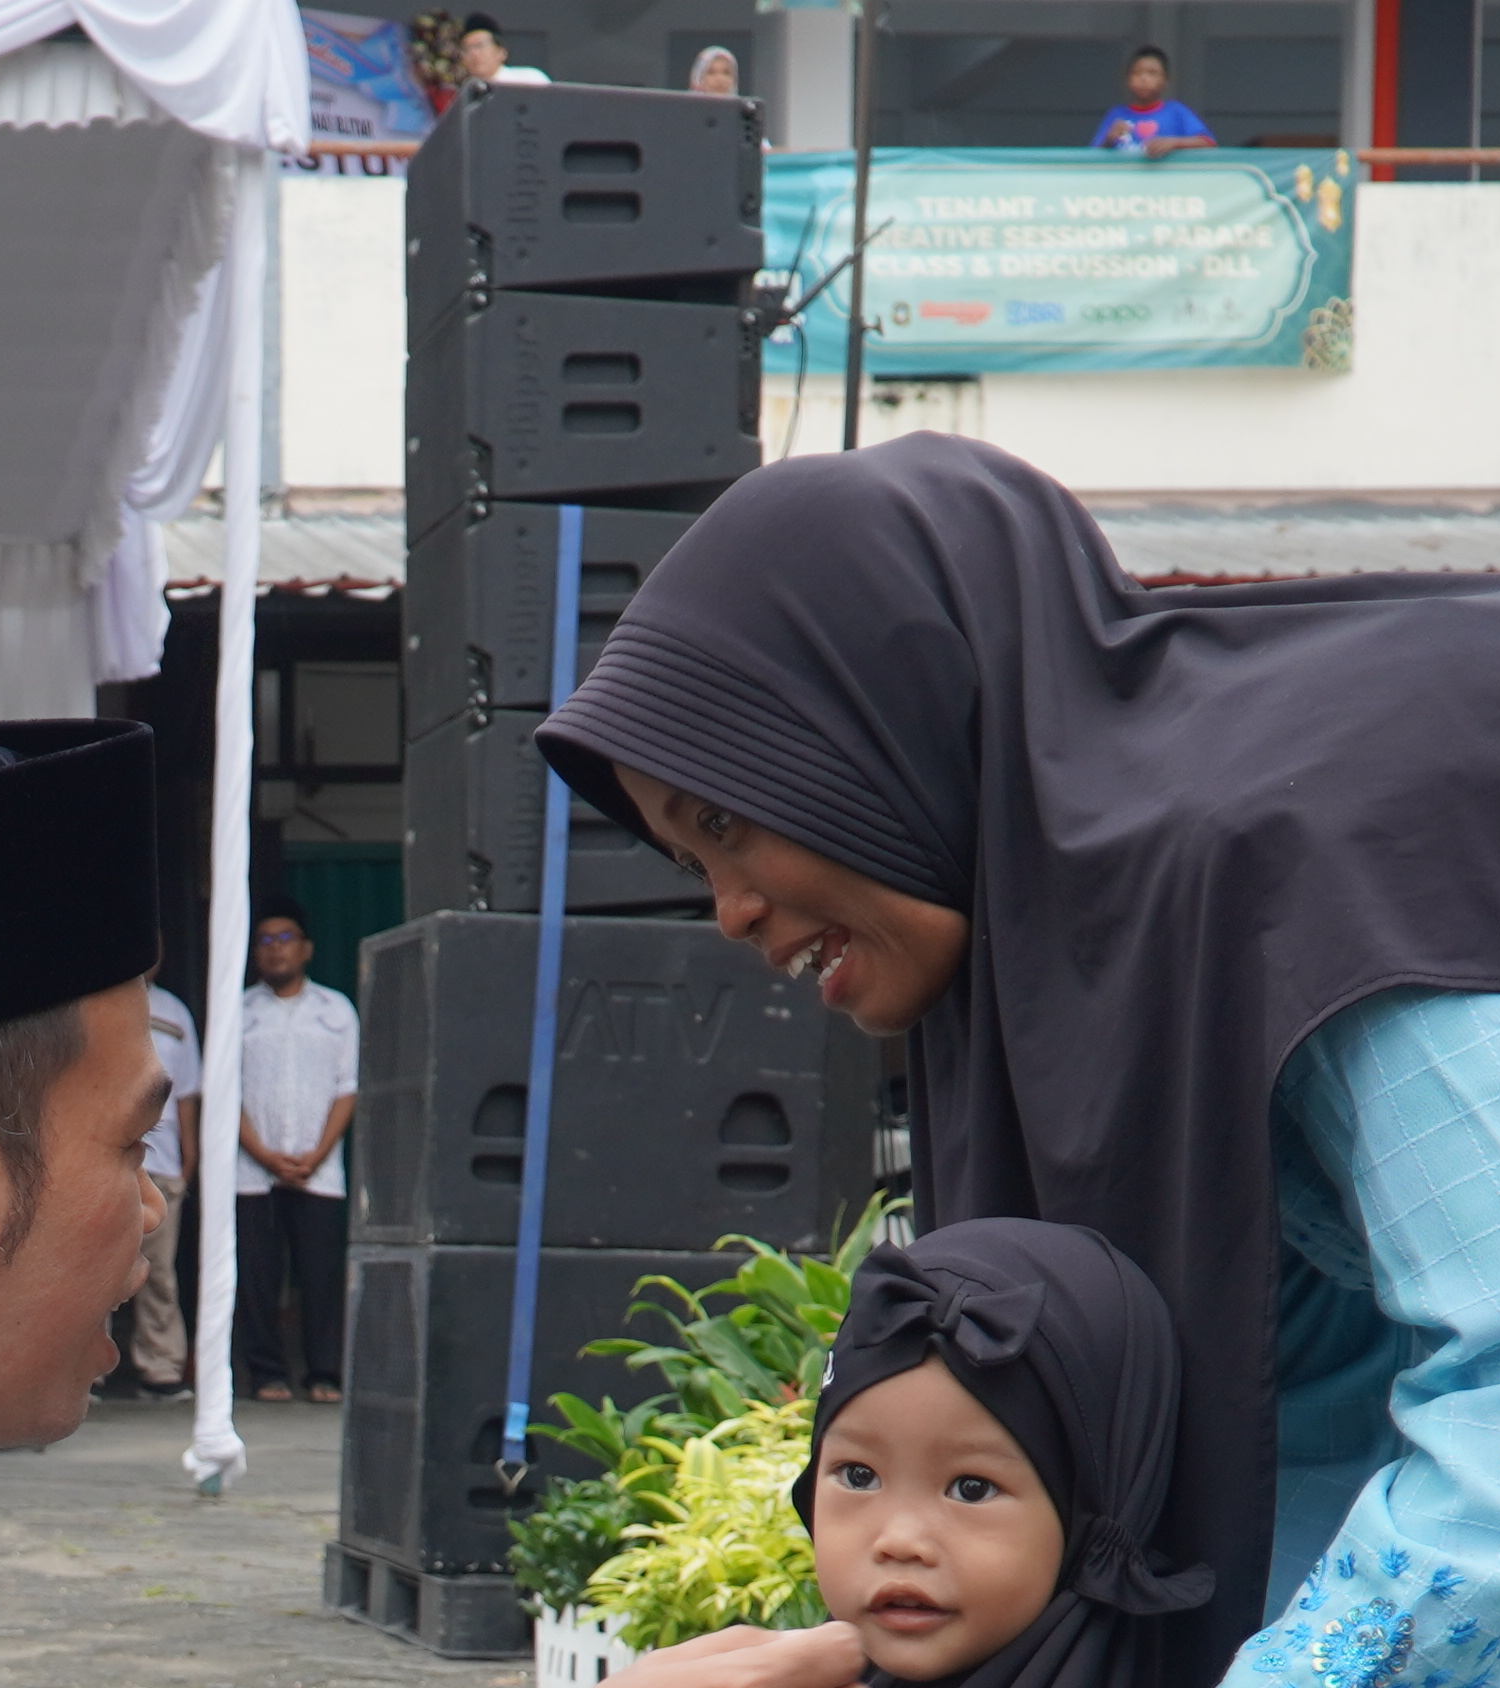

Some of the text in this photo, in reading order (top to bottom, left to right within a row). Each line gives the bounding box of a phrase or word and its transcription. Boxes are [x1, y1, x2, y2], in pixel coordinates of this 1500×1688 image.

[915, 195, 1036, 220] TENANT
[1062, 195, 1206, 220] VOUCHER
[866, 224, 995, 249] REATIVE
[1003, 224, 1130, 249] SESSION
[1153, 223, 1274, 249] PARADE
[869, 253, 963, 278] CLASS
[971, 253, 993, 278] &
[1001, 253, 1180, 279] DISCUSSION
[1203, 254, 1260, 279] DLL
